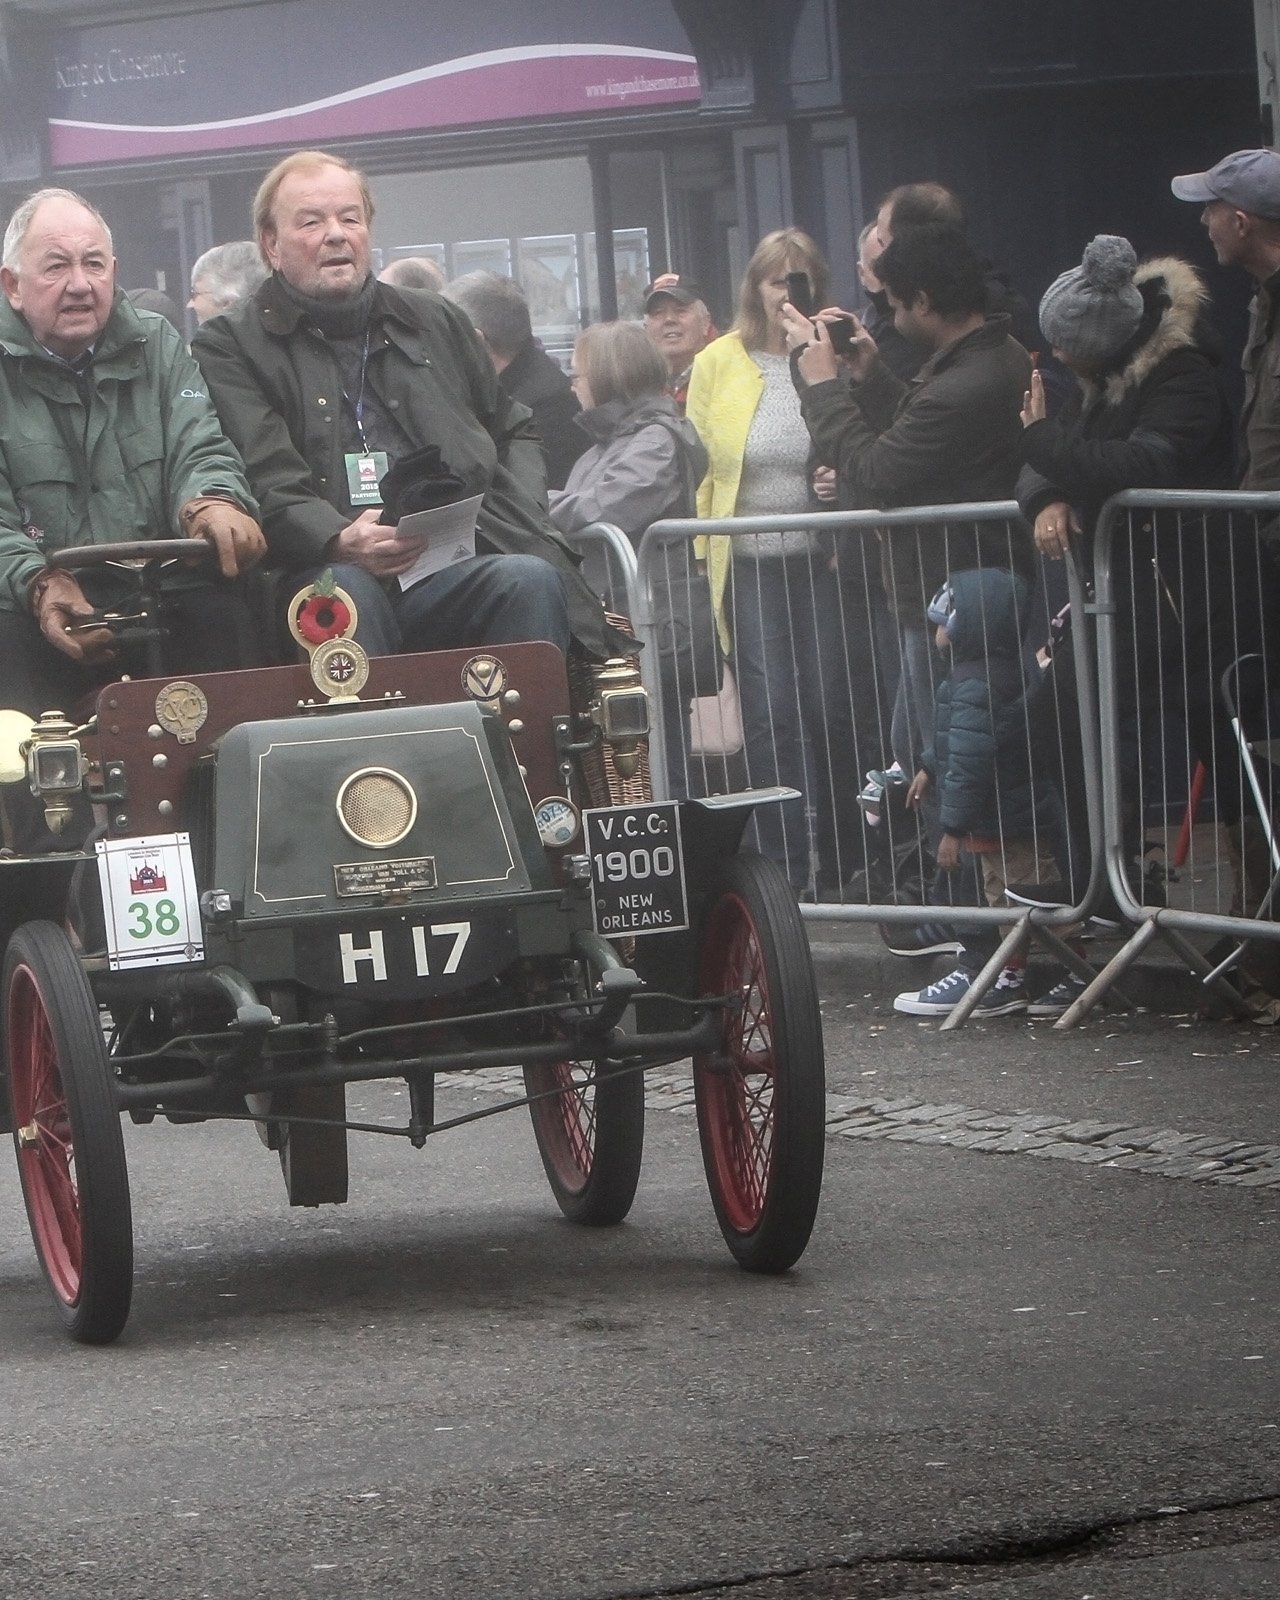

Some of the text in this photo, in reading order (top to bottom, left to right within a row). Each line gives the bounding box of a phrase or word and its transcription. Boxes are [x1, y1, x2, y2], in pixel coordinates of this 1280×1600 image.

[55, 57, 88, 98] King
[360, 483, 379, 491] 2015
[594, 846, 675, 883] 1900
[128, 899, 180, 939] 38
[602, 909, 673, 930] ORLEANS
[619, 893, 654, 909] NEW
[339, 921, 472, 984] H 17
